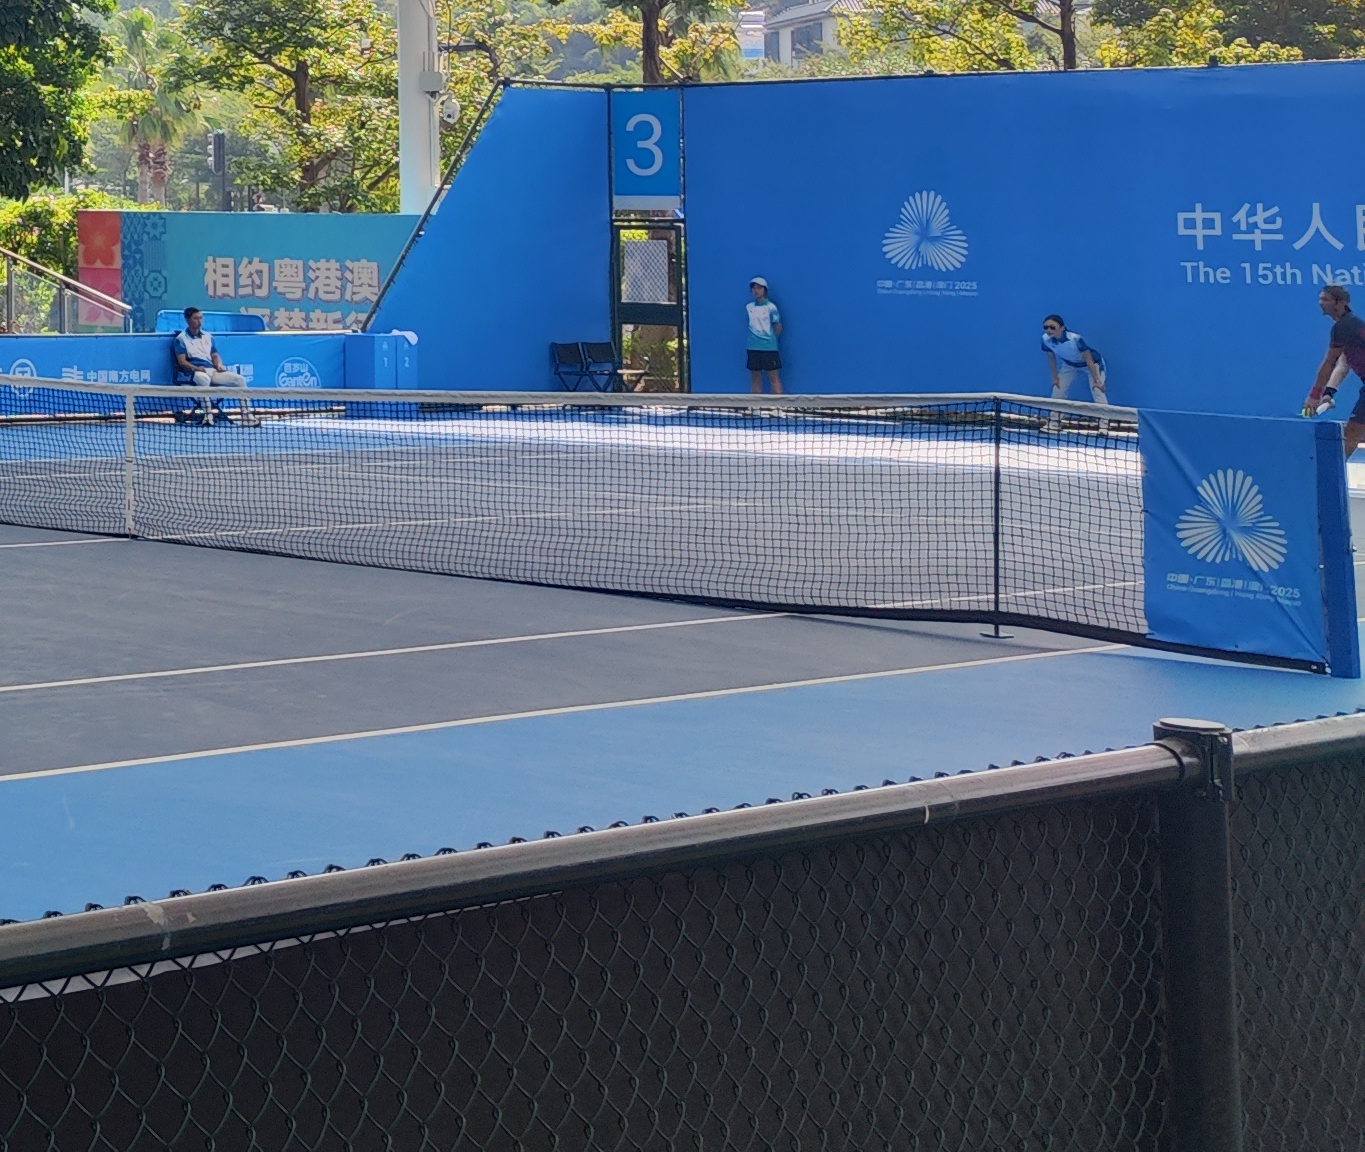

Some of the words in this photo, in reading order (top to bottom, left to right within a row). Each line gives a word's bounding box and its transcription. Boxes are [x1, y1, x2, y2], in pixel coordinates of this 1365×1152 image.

[626, 114, 663, 176] 3
[1177, 203, 1365, 251] 中华人
[204, 256, 381, 304] 相约粤港澳
[955, 281, 977, 289] 2025
[1180, 261, 1231, 284] The
[1241, 262, 1302, 285] 15th
[1270, 585, 1301, 598] 2025
